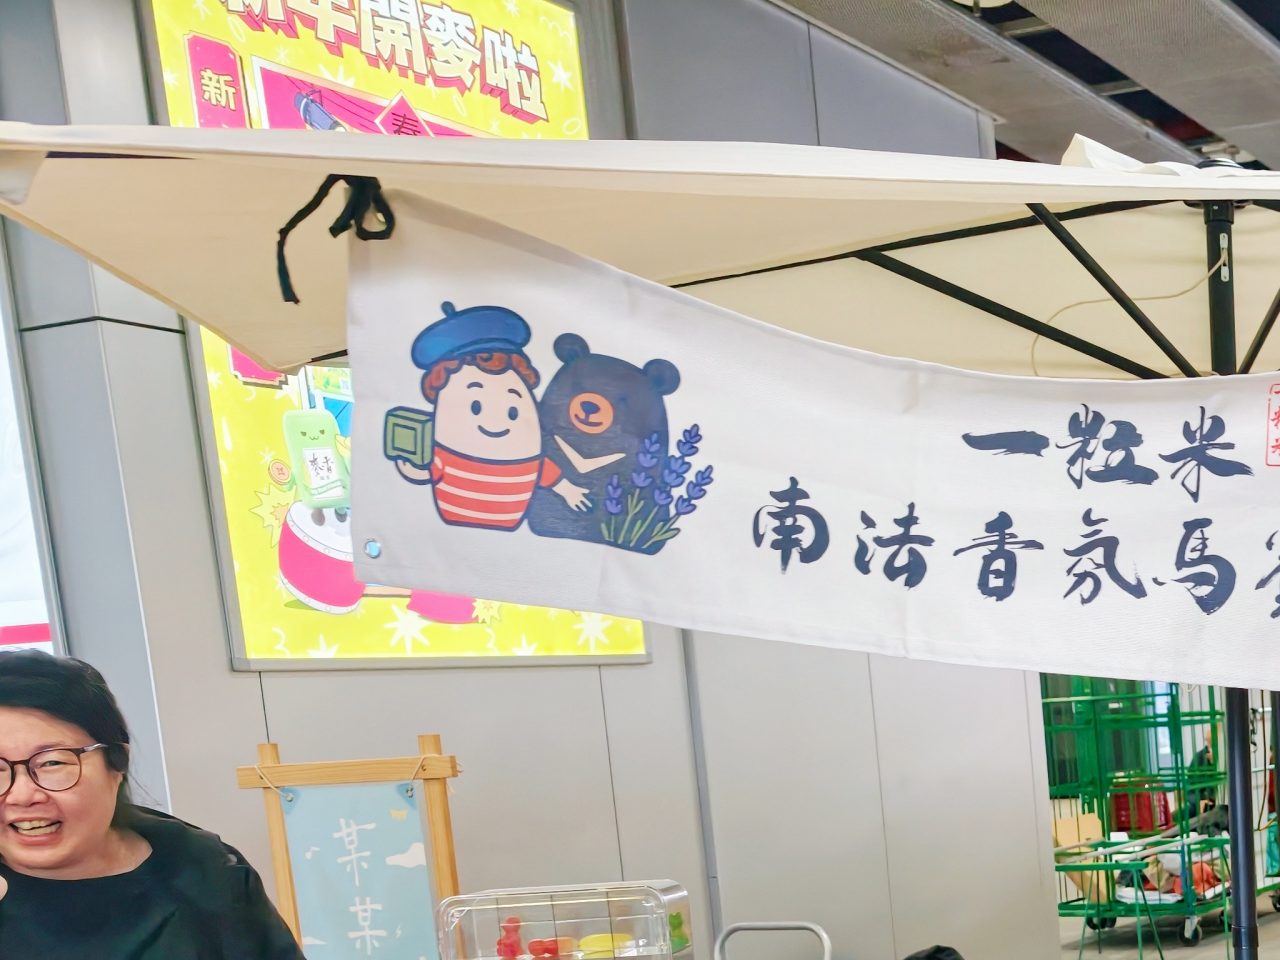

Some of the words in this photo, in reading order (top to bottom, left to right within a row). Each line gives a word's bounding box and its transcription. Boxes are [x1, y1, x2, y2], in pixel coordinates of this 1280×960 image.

[199, 68, 238, 111] 新
[961, 402, 1255, 503] 一粒米
